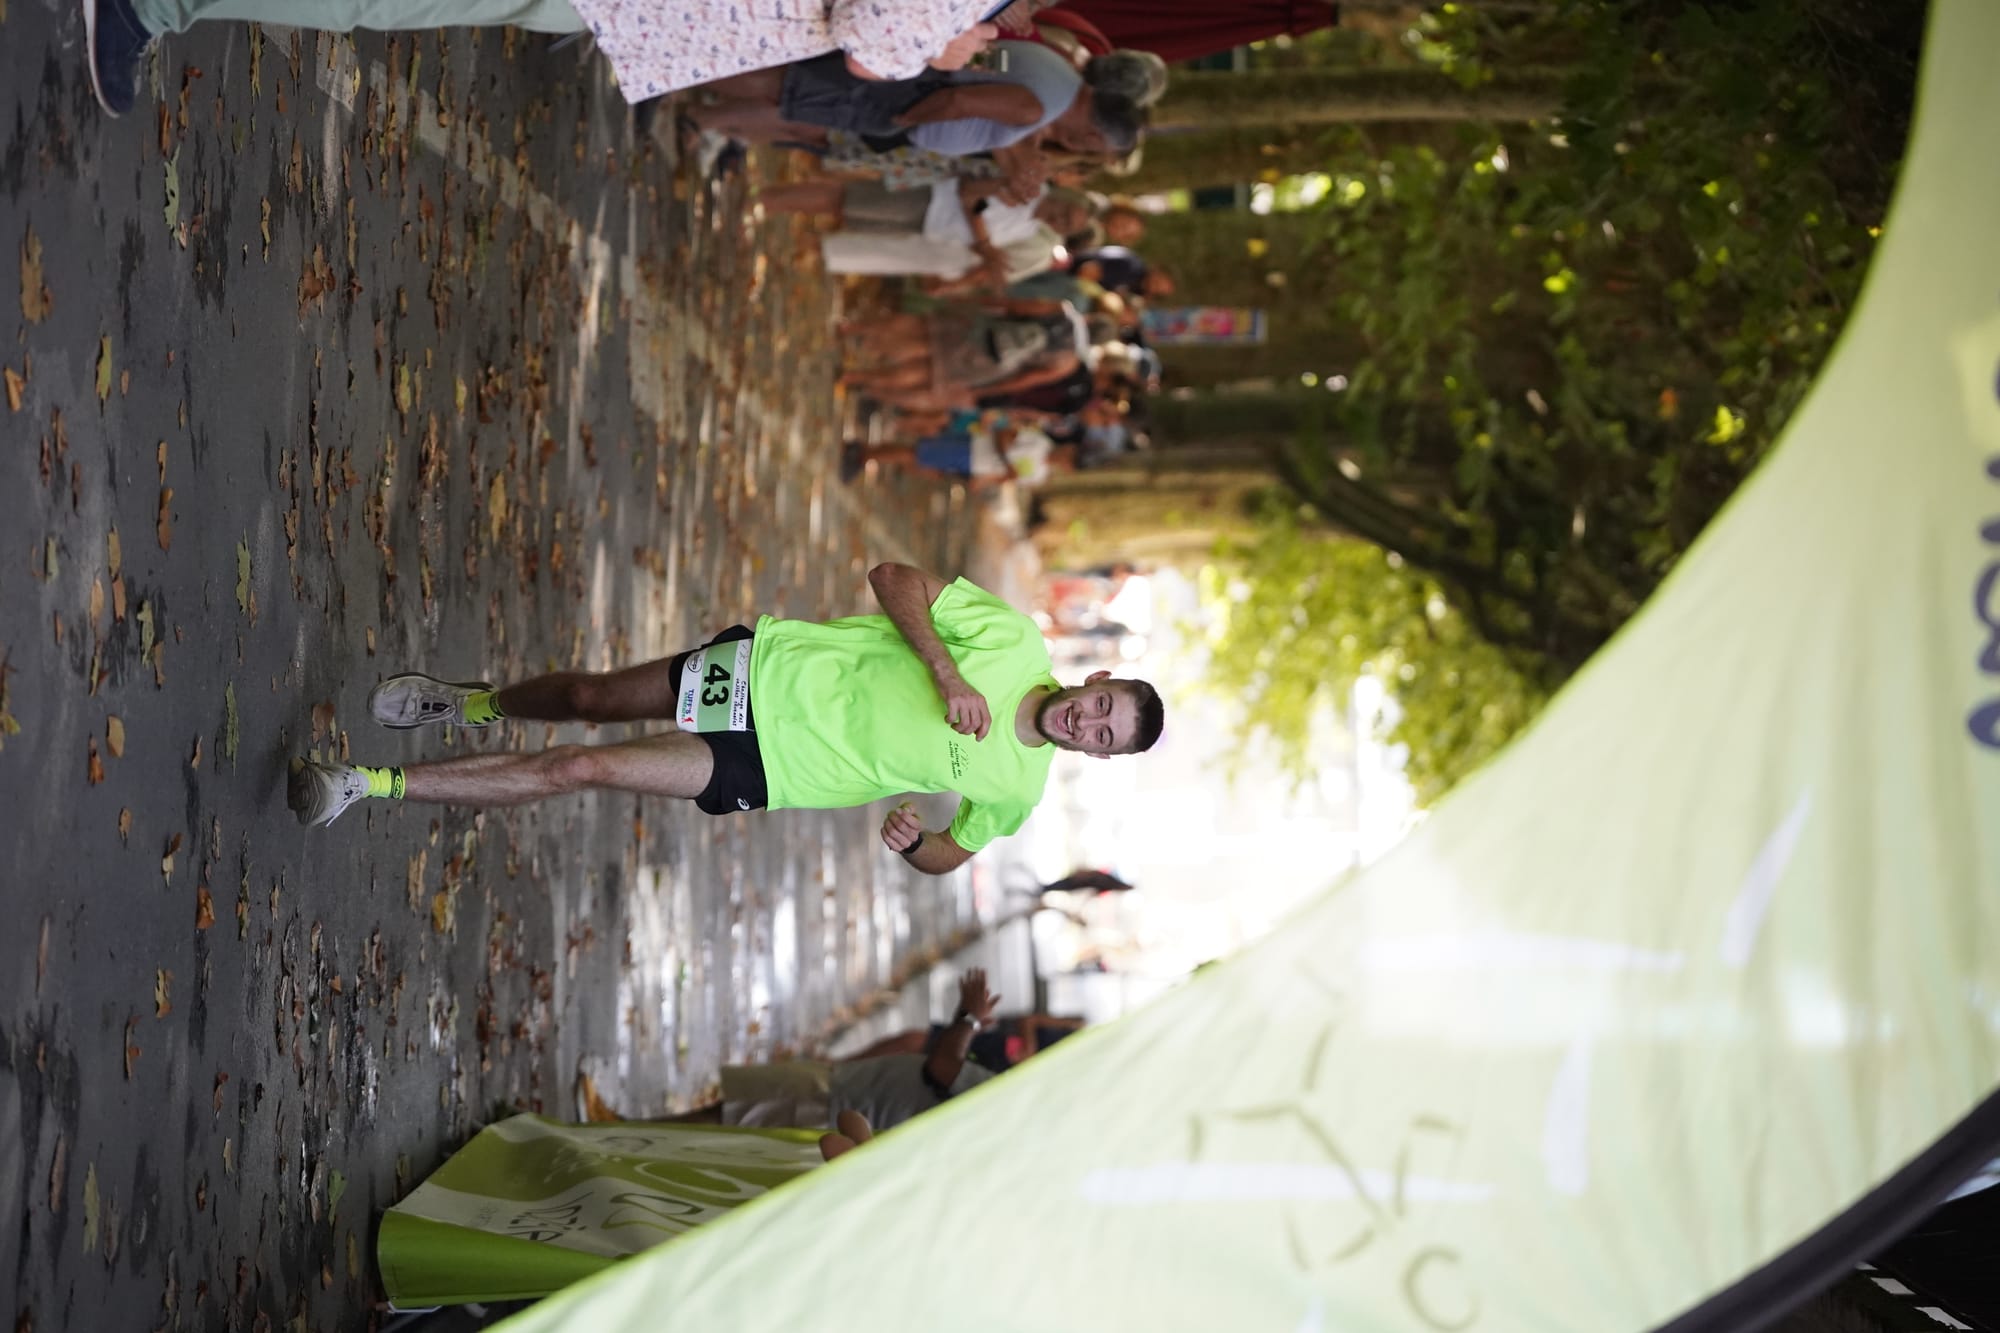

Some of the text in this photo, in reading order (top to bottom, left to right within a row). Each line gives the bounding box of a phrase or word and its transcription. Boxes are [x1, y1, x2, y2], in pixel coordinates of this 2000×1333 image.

[702, 663, 731, 707] 43
[739, 680, 747, 710] Challenge
[685, 688, 695, 715] TUFF'S
